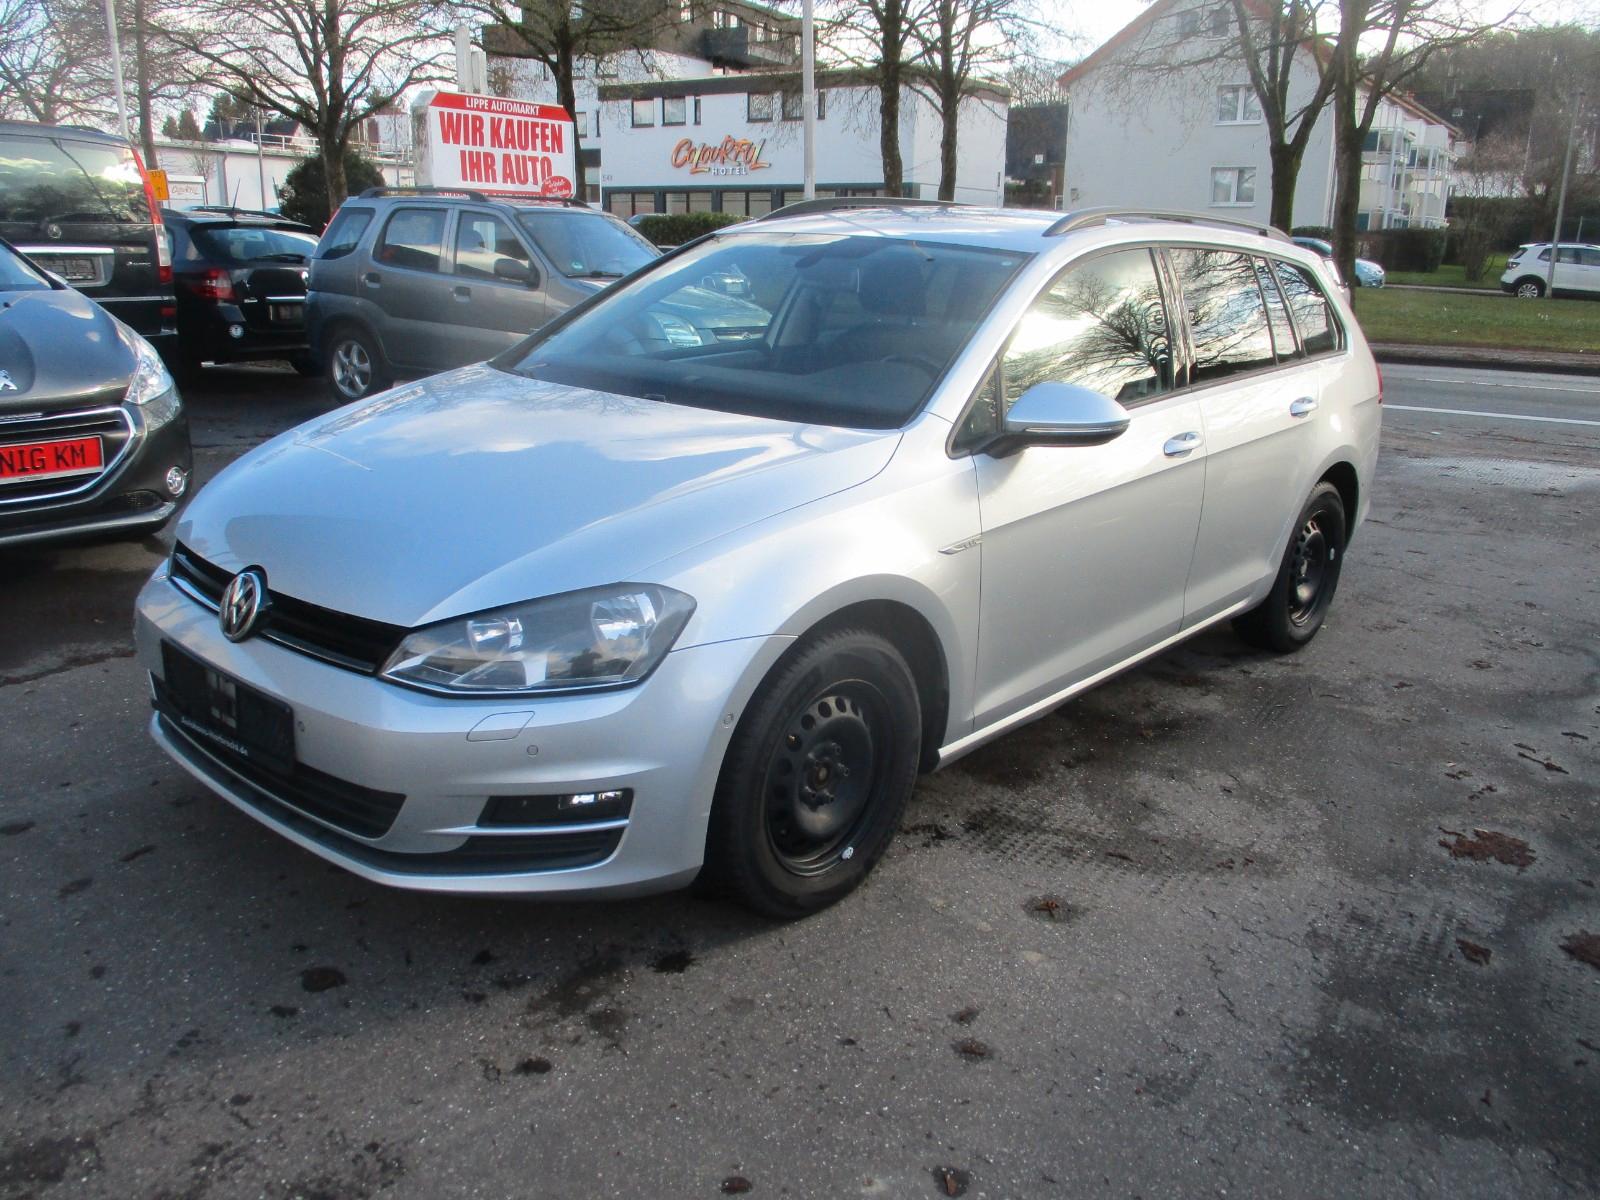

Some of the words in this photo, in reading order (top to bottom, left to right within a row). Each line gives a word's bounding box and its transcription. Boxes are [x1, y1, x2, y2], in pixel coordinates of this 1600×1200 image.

[466, 97, 489, 110] LIPPE
[491, 101, 540, 116] AUTOMARKT
[439, 111, 485, 147] WIR
[490, 116, 563, 153] KAUFEN
[460, 150, 497, 184] IHR
[502, 153, 553, 186] AUTO
[712, 167, 748, 175] HOTEL
[54, 443, 86, 469] KM
